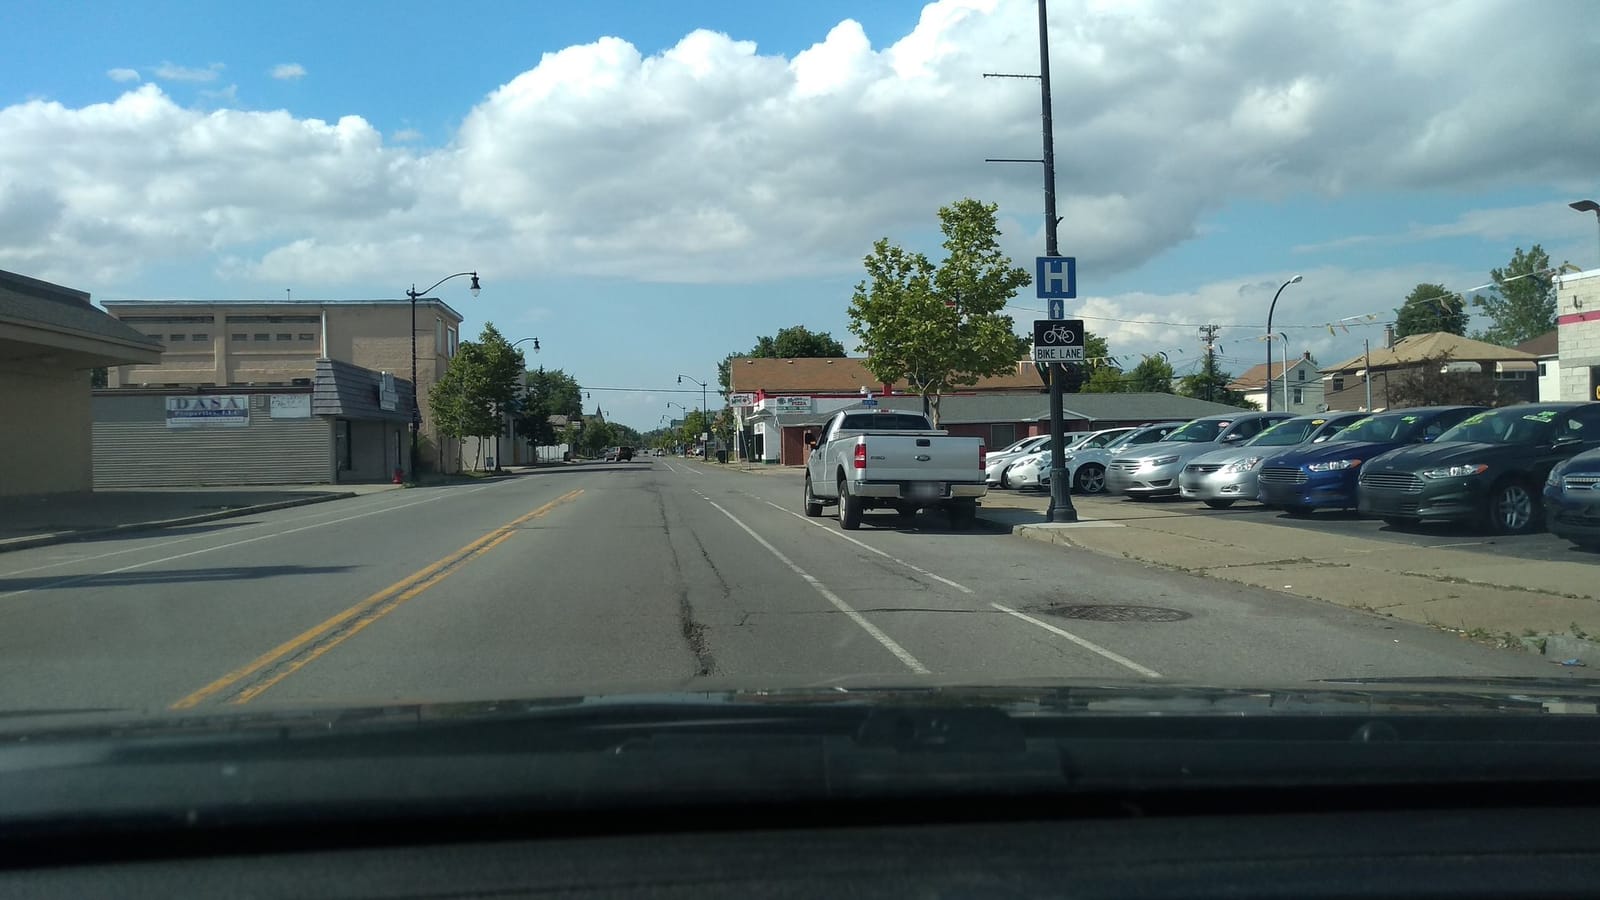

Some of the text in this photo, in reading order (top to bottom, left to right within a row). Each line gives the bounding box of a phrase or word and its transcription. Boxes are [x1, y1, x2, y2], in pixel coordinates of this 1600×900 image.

[1044, 262, 1069, 293] H
[1037, 348, 1082, 359] BIKE LANE
[176, 396, 239, 409] DASA
